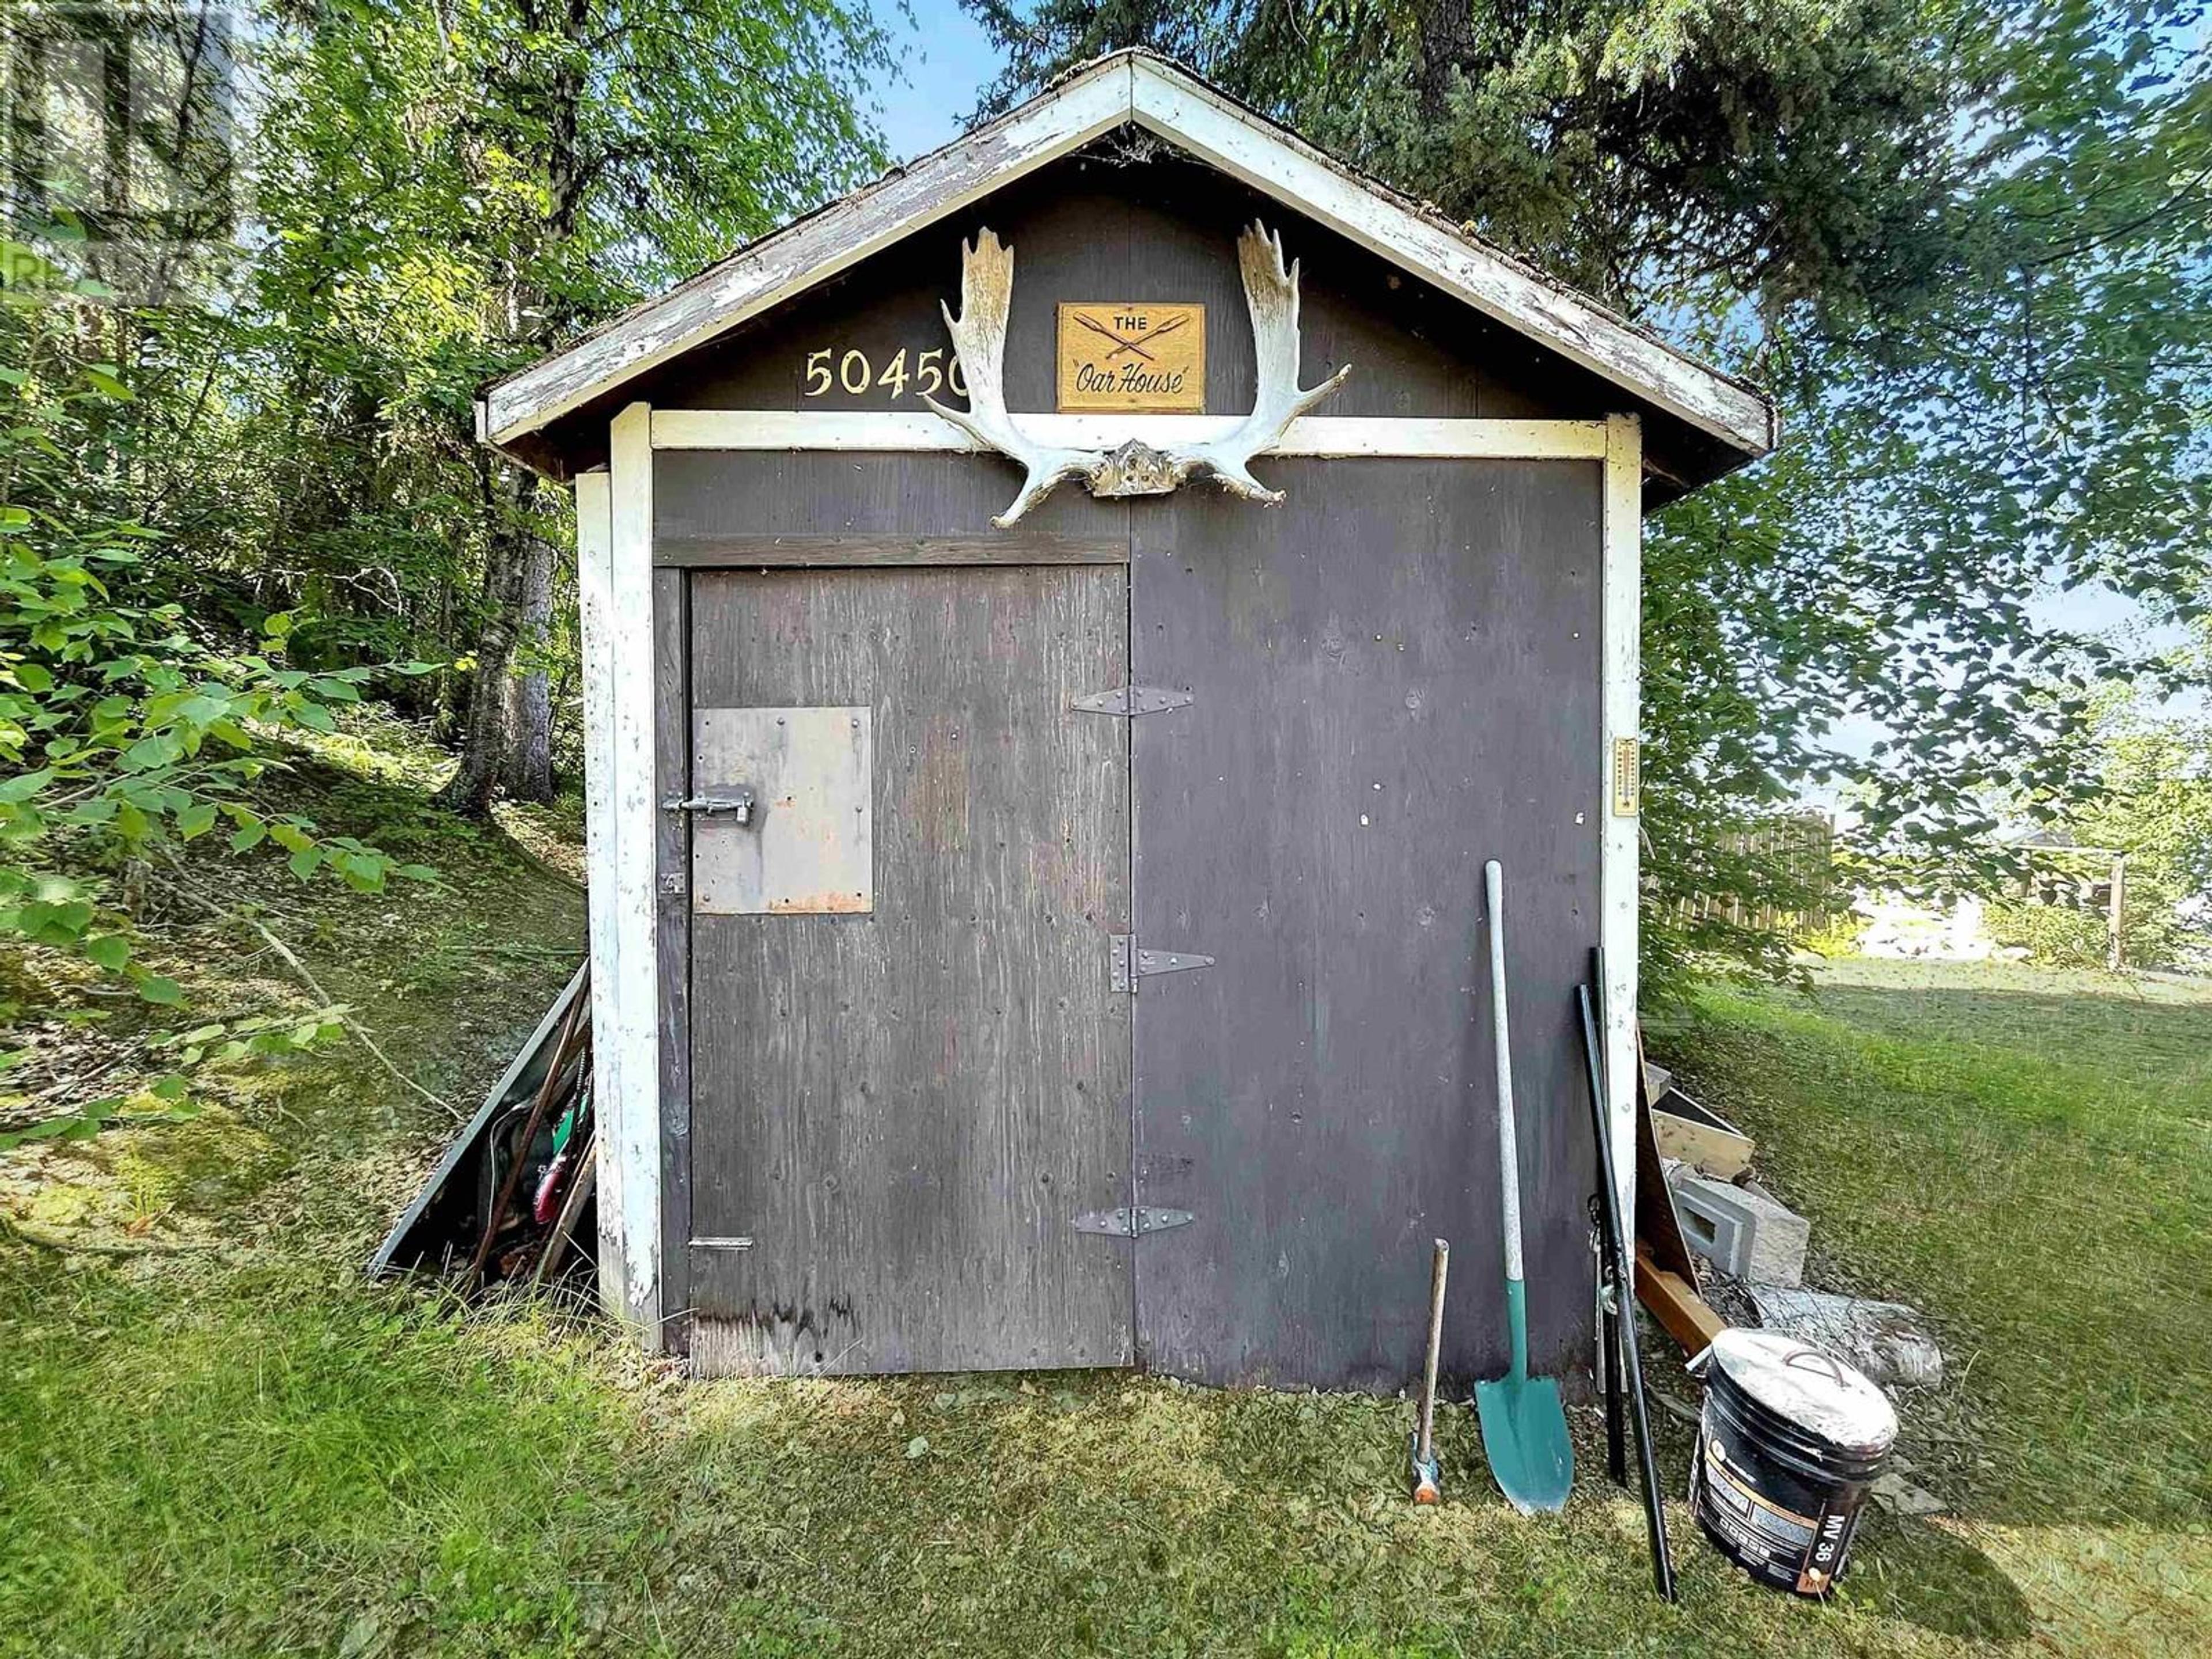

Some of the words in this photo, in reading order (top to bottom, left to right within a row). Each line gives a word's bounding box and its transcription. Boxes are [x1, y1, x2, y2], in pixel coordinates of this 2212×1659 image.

[1113, 316, 1147, 330] THE
[1822, 1514, 1845, 1540] MV
[1815, 1542, 1835, 1562] 36
